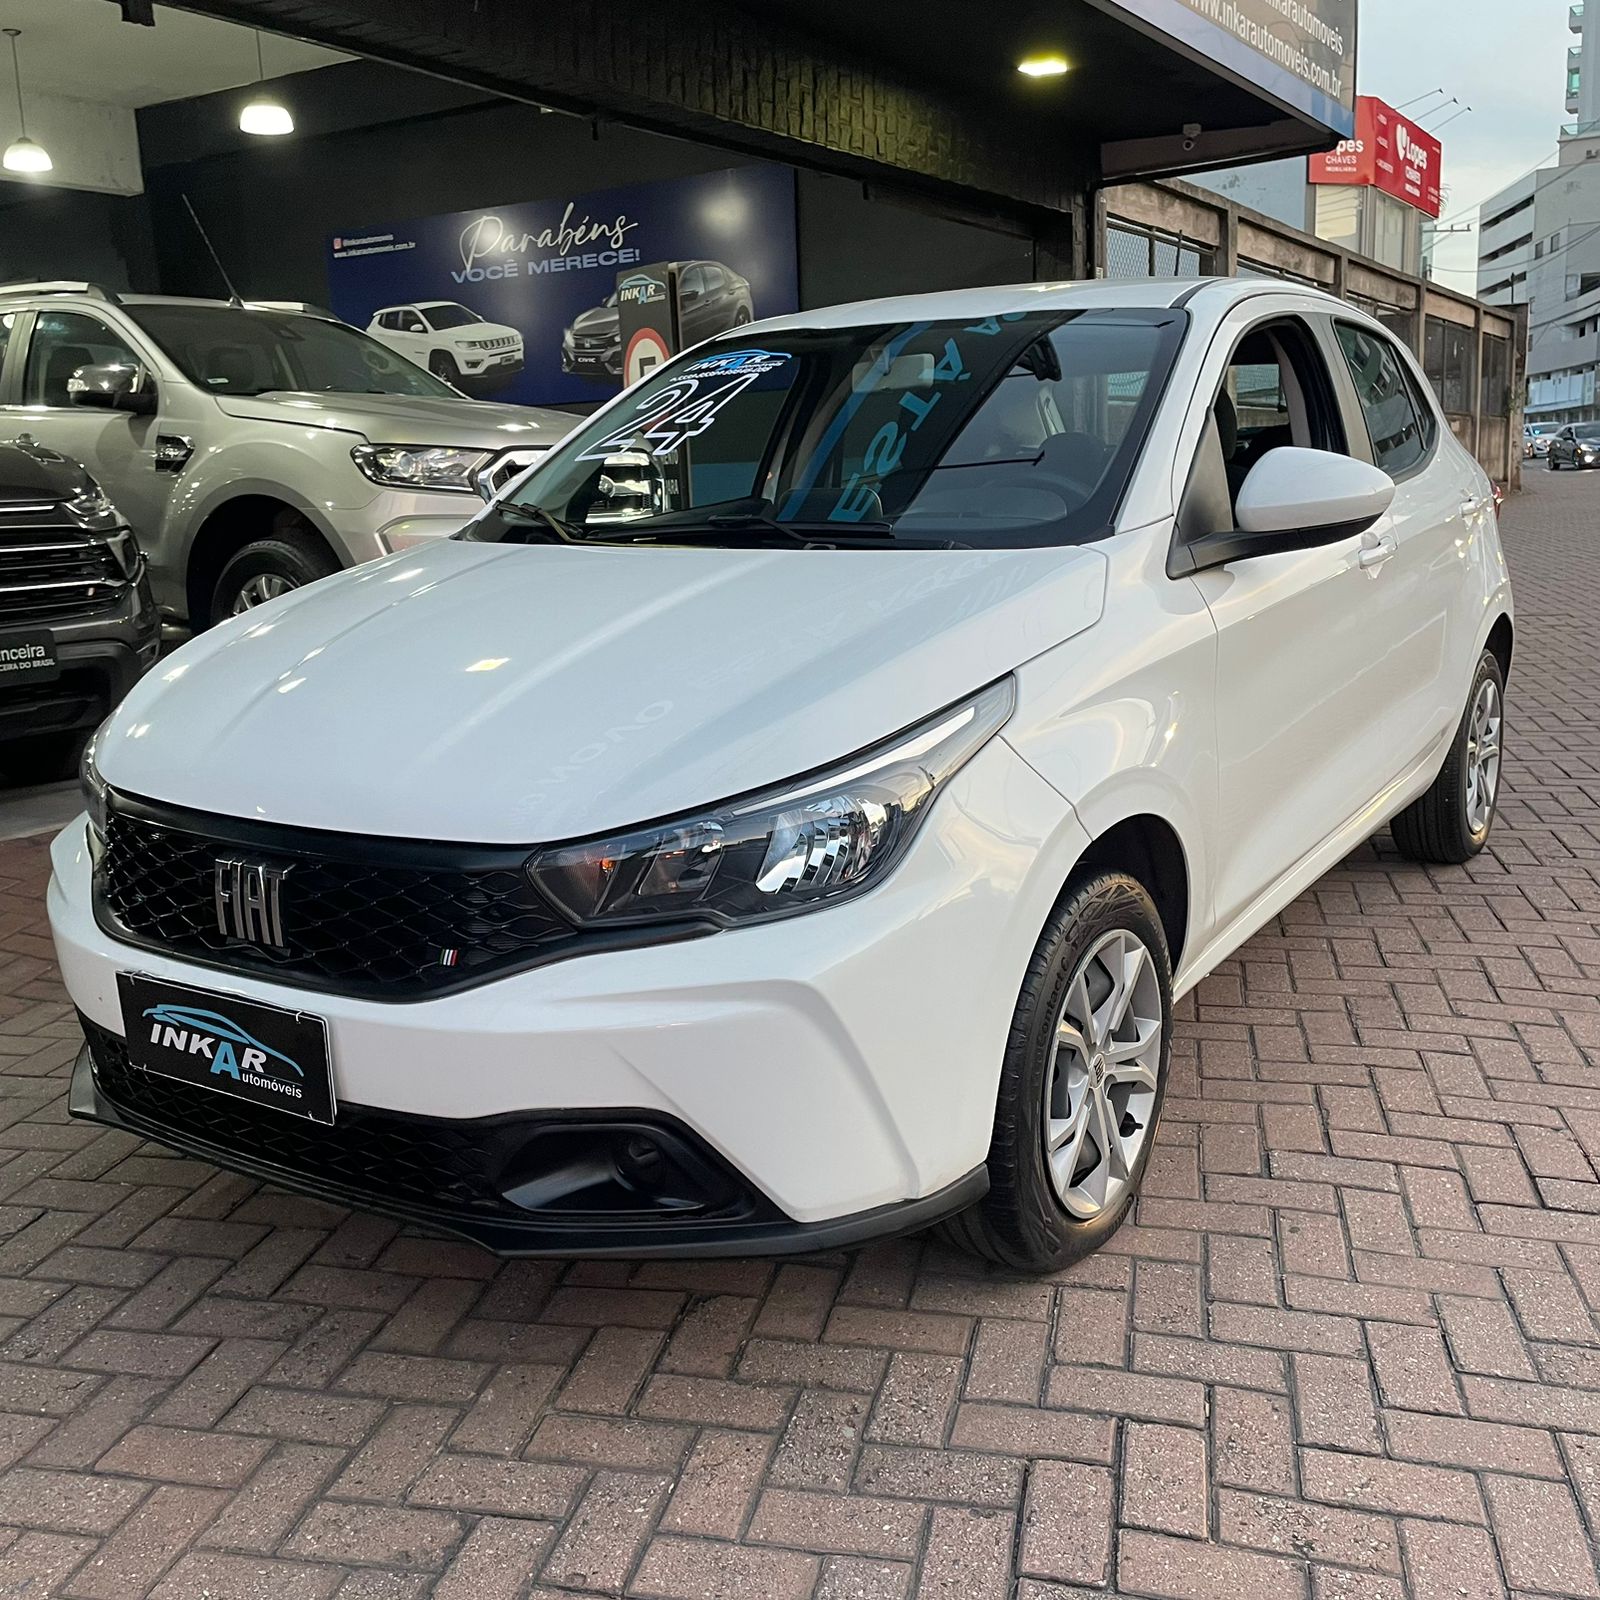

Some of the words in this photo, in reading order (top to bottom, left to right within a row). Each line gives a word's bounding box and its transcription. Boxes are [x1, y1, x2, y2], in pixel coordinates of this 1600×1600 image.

[1325, 155, 1357, 164] CHAVES
[1336, 139, 1364, 155] pes
[1406, 136, 1427, 169] Lopes
[459, 202, 639, 272] Parabéns
[450, 259, 518, 284] VOCÊ
[527, 248, 640, 276] MERECE!
[620, 284, 656, 304] INKAR
[575, 373, 759, 462] 24
[0, 643, 46, 661] nceira
[19, 661, 32, 669] DO
[215, 858, 287, 948] FIAT
[150, 1023, 267, 1081] INKAR
